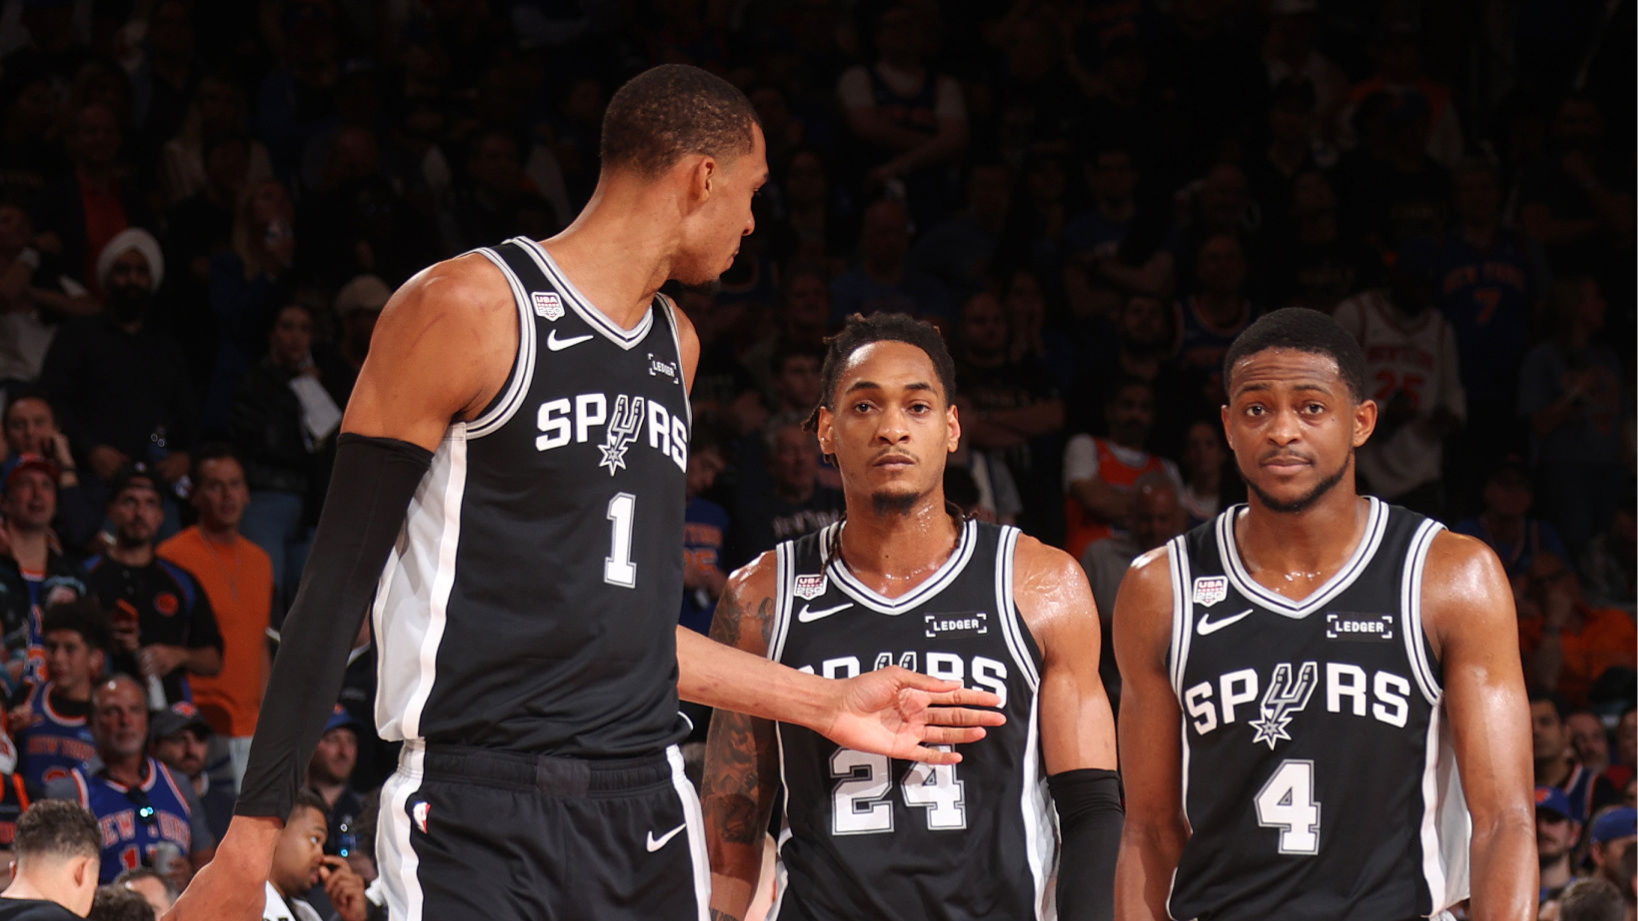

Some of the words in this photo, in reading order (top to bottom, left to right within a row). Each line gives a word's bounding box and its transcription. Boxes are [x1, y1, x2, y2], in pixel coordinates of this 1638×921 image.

[1474, 287, 1502, 325] 7
[535, 392, 688, 476] SPURS
[603, 491, 637, 589] 1
[933, 618, 979, 631] LEDGER
[1335, 621, 1385, 632] LEDGER
[1185, 661, 1411, 750] SPURS
[829, 742, 967, 835] 24
[1253, 759, 1321, 855] 4
